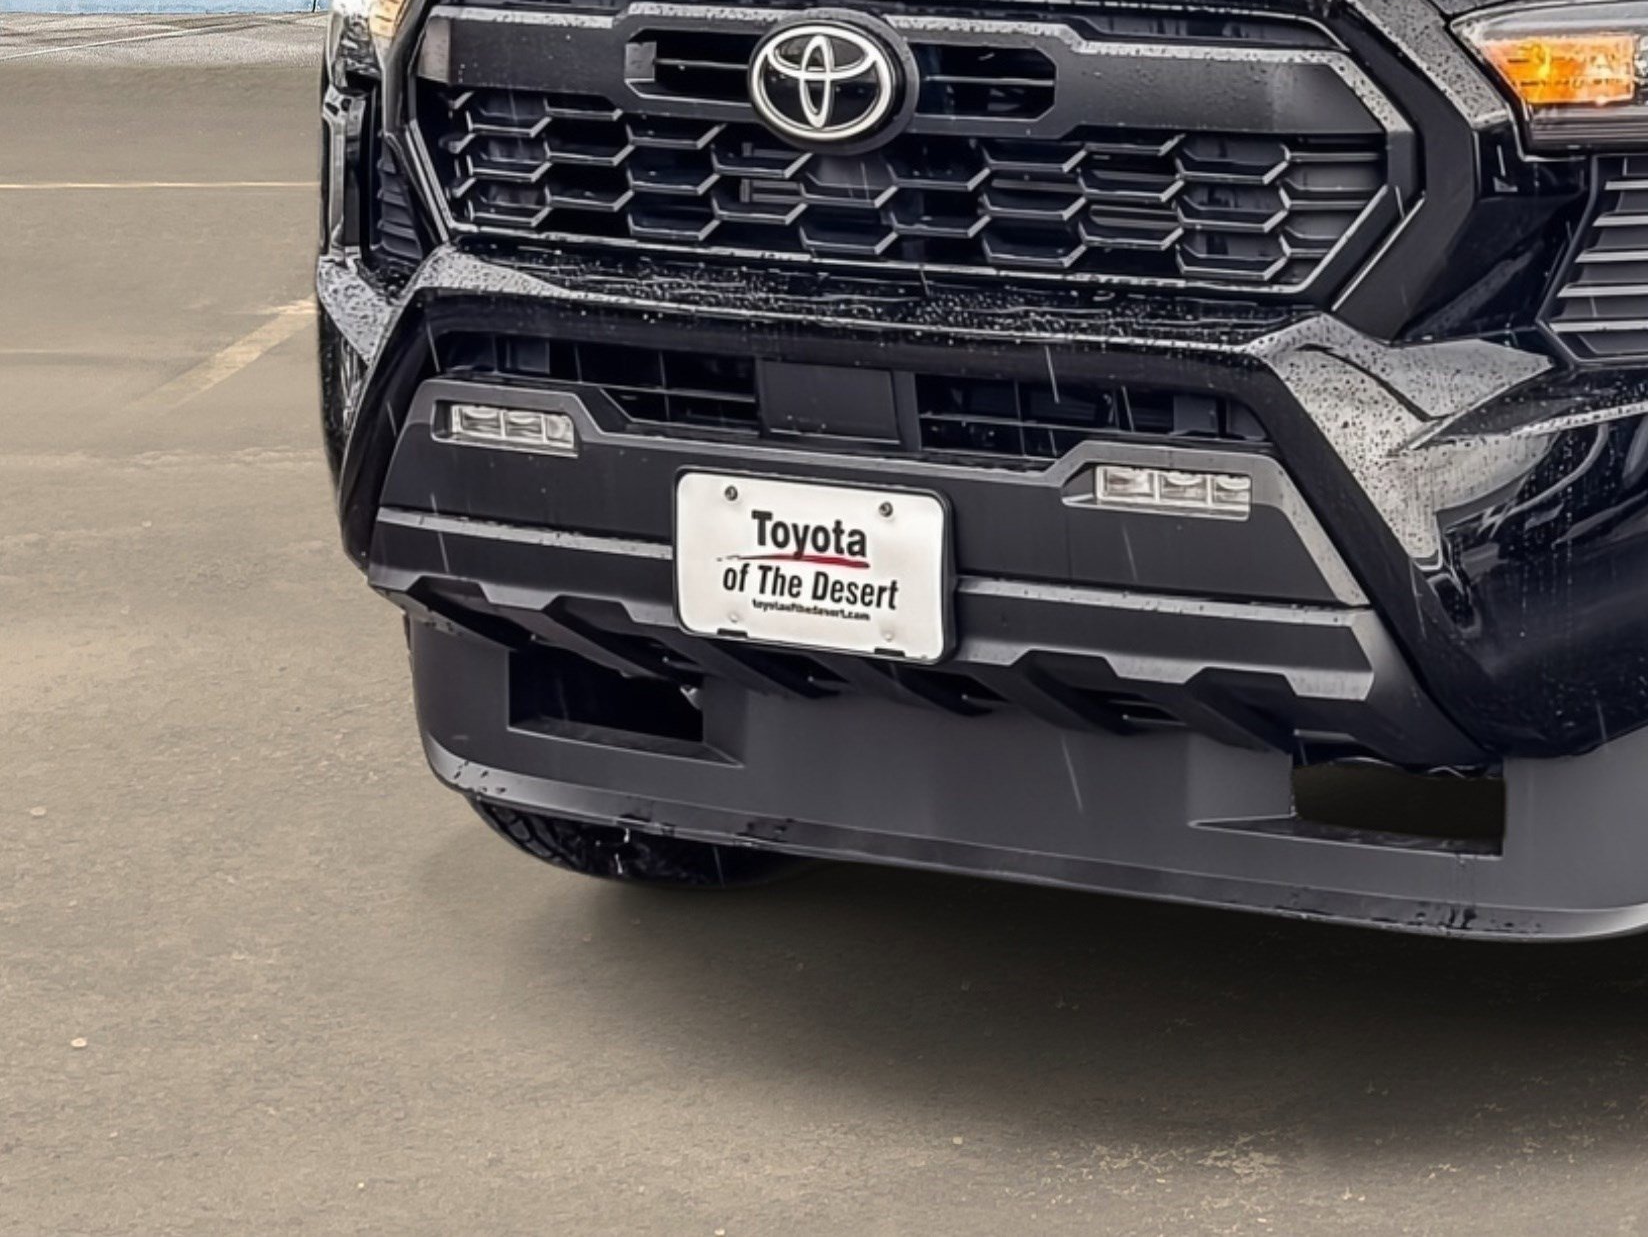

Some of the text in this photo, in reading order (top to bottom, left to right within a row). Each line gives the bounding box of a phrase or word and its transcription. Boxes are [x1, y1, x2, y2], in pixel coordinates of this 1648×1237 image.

[751, 509, 868, 559] Toyota
[722, 562, 899, 610] of The Desert
